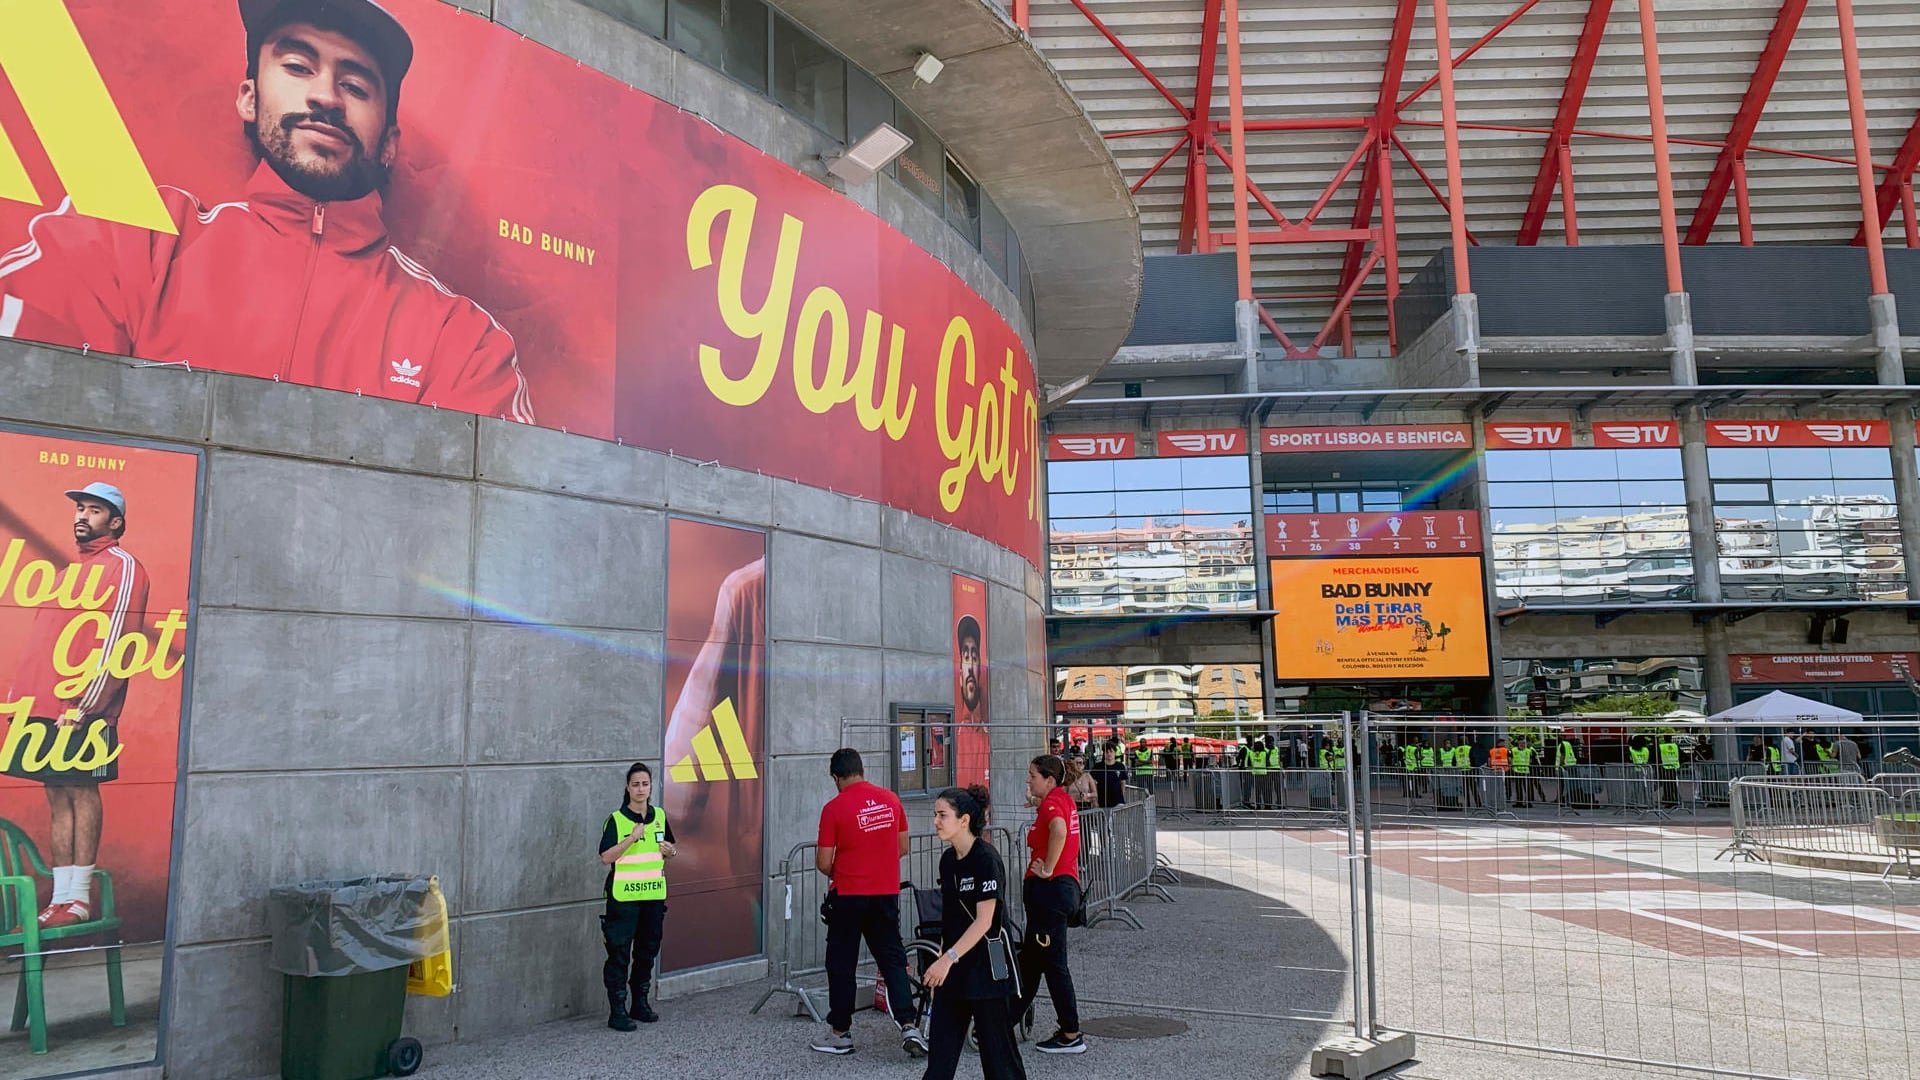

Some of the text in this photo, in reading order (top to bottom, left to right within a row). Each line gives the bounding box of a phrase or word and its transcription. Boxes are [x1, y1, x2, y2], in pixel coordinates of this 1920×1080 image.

[499, 218, 595, 266] BAD BUNNY
[687, 184, 917, 440] You
[935, 316, 1019, 513] Got
[390, 375, 420, 388] adidas
[1269, 430, 1466, 446] SPORT LISBOA E BENFICA
[1494, 427, 1562, 444] BTV
[1602, 426, 1669, 443] BTV
[1714, 425, 1780, 442] BTV
[1806, 425, 1872, 442] BTV
[1058, 437, 1126, 455] BTV
[1167, 434, 1236, 452] BTV
[40, 451, 126, 471] BAD BUNNY
[1310, 543, 1322, 551] 26
[1348, 542, 1361, 550] 38
[1393, 541, 1400, 549] 2
[1425, 541, 1437, 549] 10
[1459, 540, 1466, 548] 8
[1333, 566, 1419, 575] MERCHANDISING
[1321, 582, 1432, 598] BAD BUNNY
[52, 609, 187, 699] Got
[1815, 654, 1841, 663] FÉRIAS
[1842, 655, 1873, 663] FUTEBOL
[624, 881, 664, 892] ASSISTEN
[982, 880, 997, 892] 220
